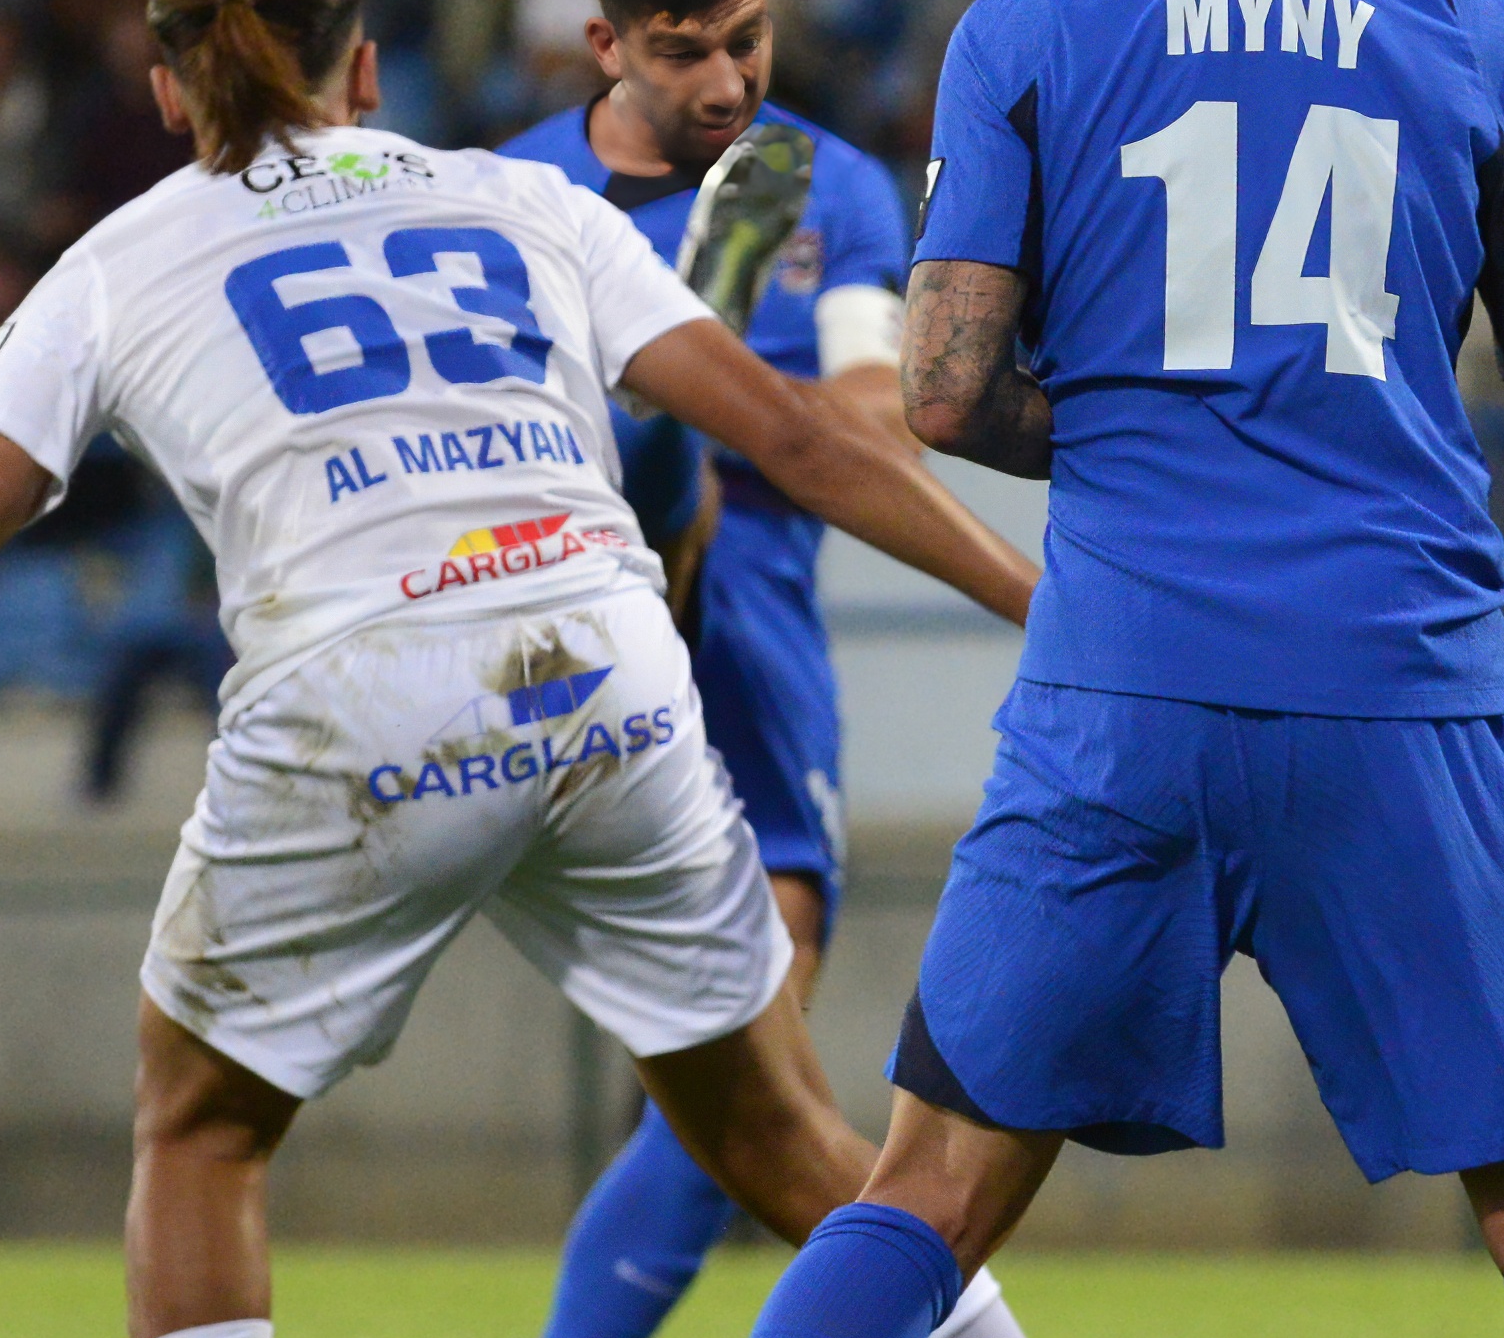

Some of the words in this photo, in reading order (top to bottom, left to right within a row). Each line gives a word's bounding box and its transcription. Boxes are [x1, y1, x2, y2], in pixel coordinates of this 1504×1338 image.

[1121, 101, 1399, 381] 14
[225, 227, 554, 416] 63
[325, 447, 388, 503] AL
[391, 421, 585, 474] MAZYAN
[367, 706, 674, 803] CARGLASS
